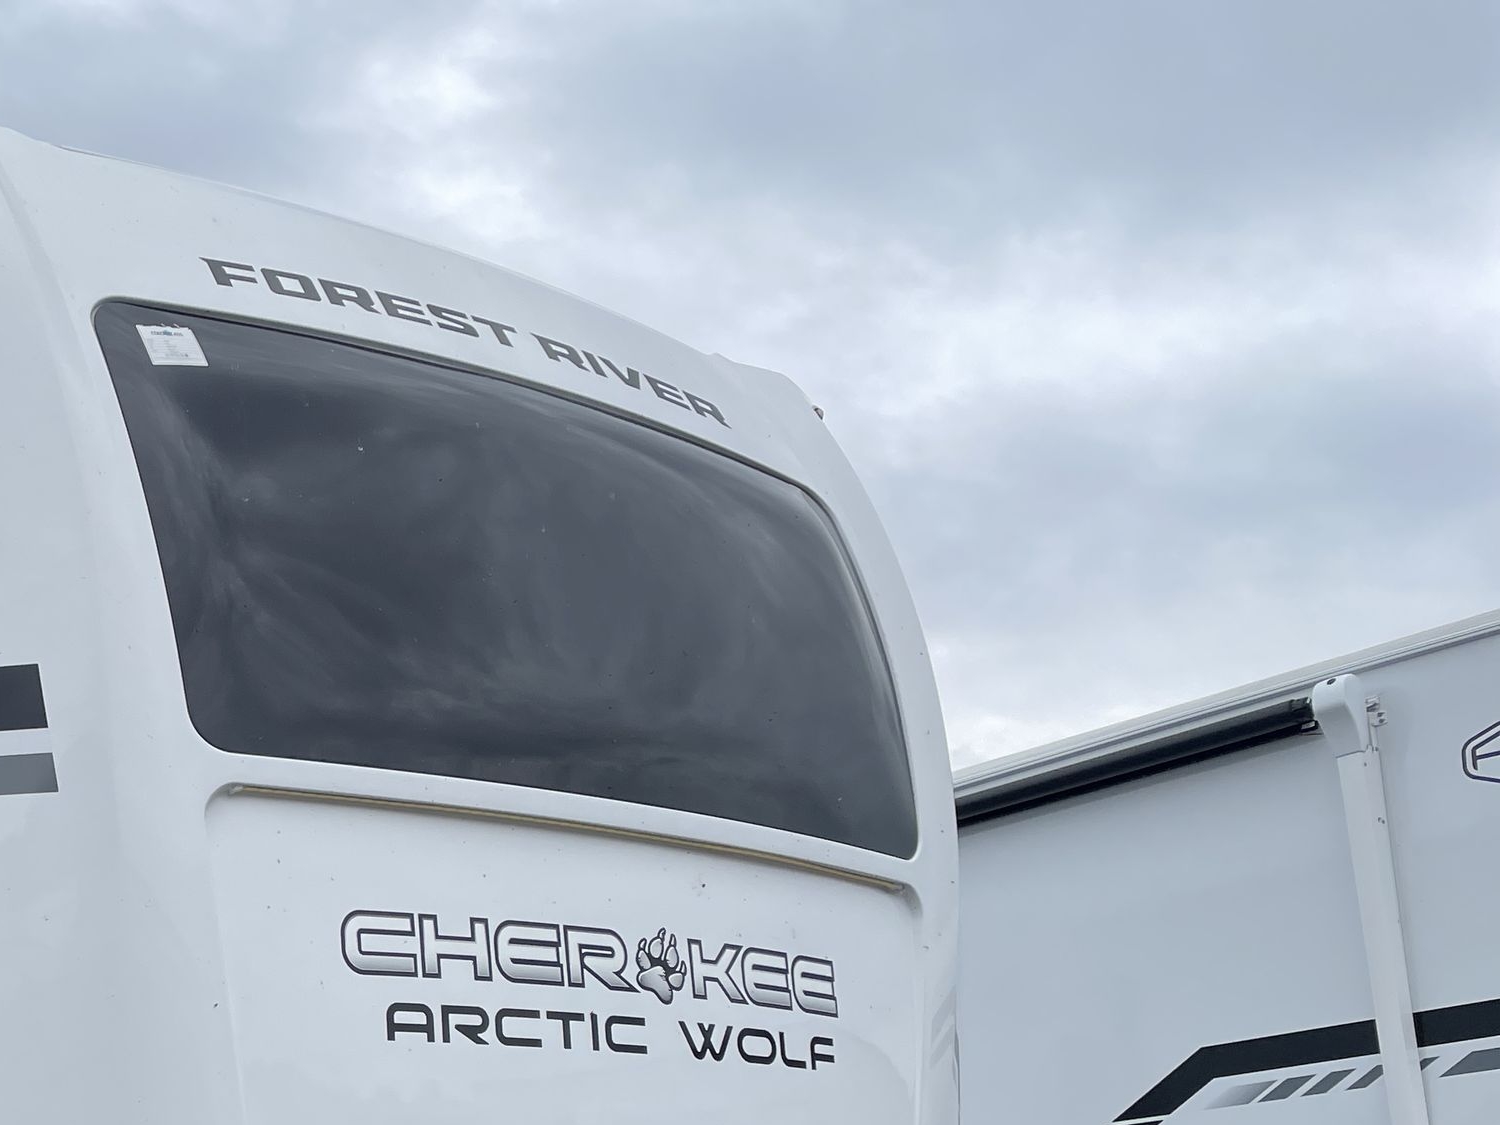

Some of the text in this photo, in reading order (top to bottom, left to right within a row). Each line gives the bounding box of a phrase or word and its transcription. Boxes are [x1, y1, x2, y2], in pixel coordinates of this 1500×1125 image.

[200, 256, 732, 429] FOREST RIVER
[340, 909, 840, 1019] CHERKEE
[386, 1002, 836, 1071] ARCTIC WOLF
